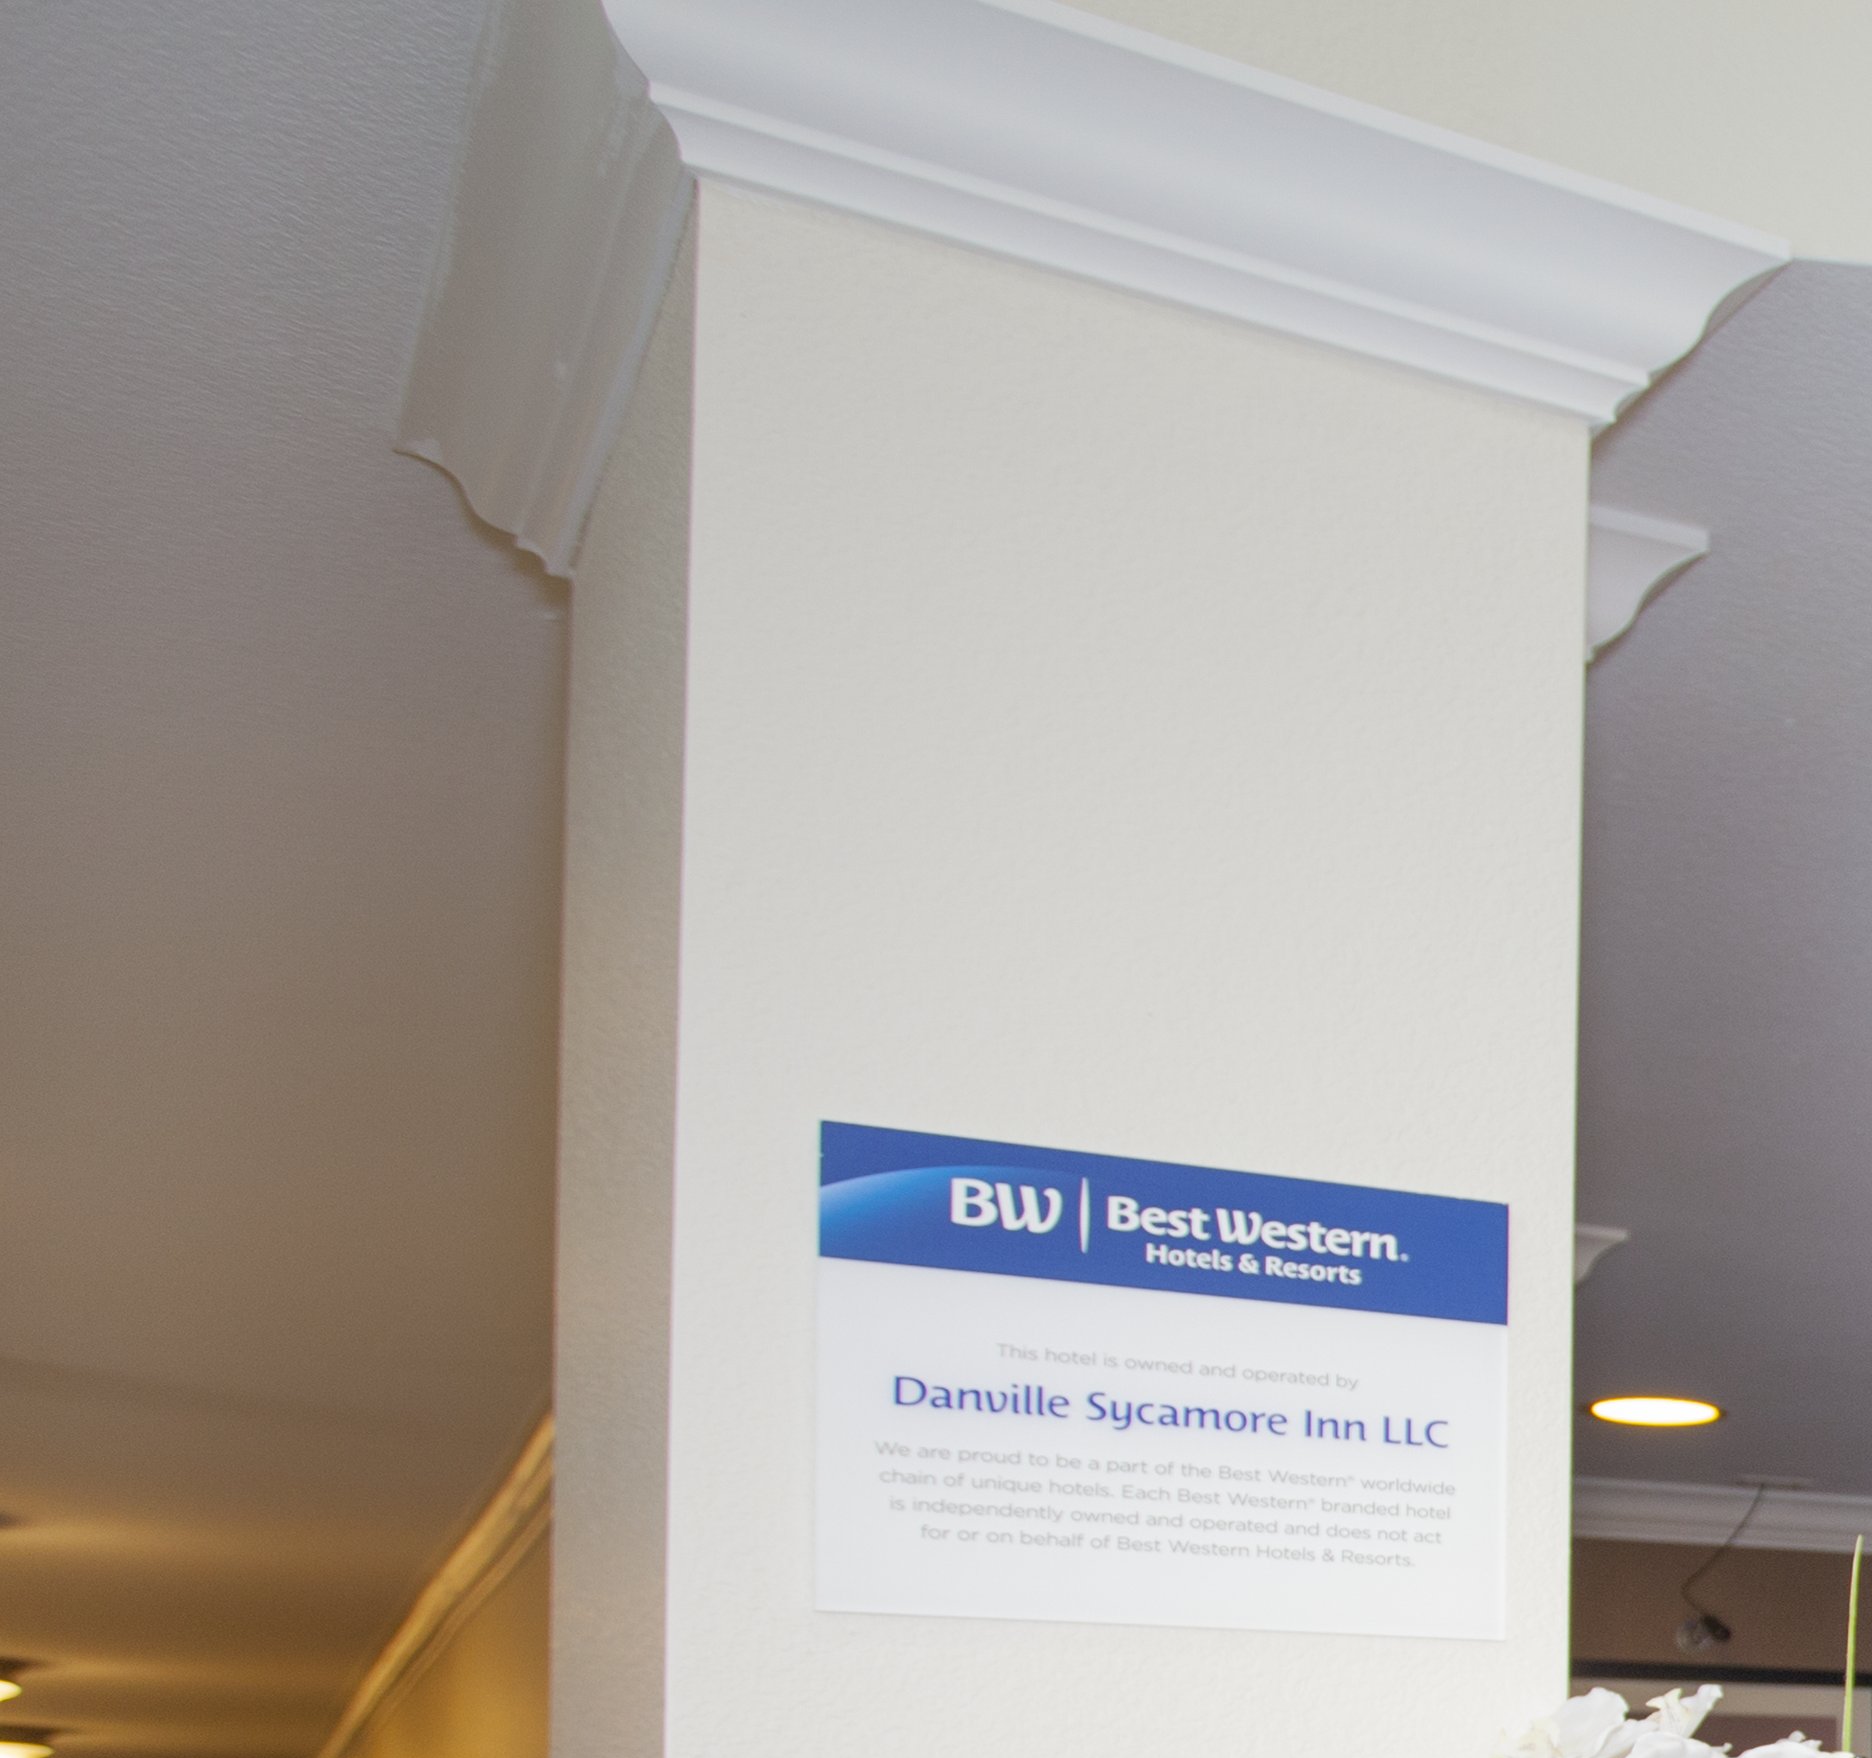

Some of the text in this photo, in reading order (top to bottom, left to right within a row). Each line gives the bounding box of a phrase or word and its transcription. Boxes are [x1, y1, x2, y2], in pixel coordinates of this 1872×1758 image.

[951, 1177, 1063, 1234] BW
[1107, 1195, 1211, 1241] Best
[1145, 1242, 1362, 1286] Hotels & Resorts
[997, 1343, 1359, 1391] This hotel is owned and operated by
[893, 1375, 1449, 1449] Danville Sycamore Inn LLC
[874, 1441, 910, 1457] We
[917, 1445, 951, 1460] are
[958, 1449, 1021, 1466] proud
[1028, 1452, 1049, 1467] to
[1056, 1454, 1081, 1470] be
[1087, 1459, 1100, 1471] a
[1106, 1459, 1148, 1475] part
[1154, 1462, 1175, 1476] of
[1181, 1463, 1212, 1479] the
[1218, 1465, 1262, 1482] Best
[1360, 1477, 1456, 1496] worldwide
[879, 1468, 937, 1486] chain
[943, 1473, 965, 1488] of
[971, 1476, 1043, 1494] unique
[1049, 1479, 1115, 1498] hotels.
[1121, 1484, 1170, 1501] Each
[1177, 1488, 1221, 1504] Best
[1321, 1498, 1400, 1516] branded
[1405, 1503, 1451, 1519] hotel
[889, 1496, 1442, 1545] is independently owned and operated and does not act
[921, 1524, 1416, 1568] for or on behalf of Best Western Hotels & Resorts.
